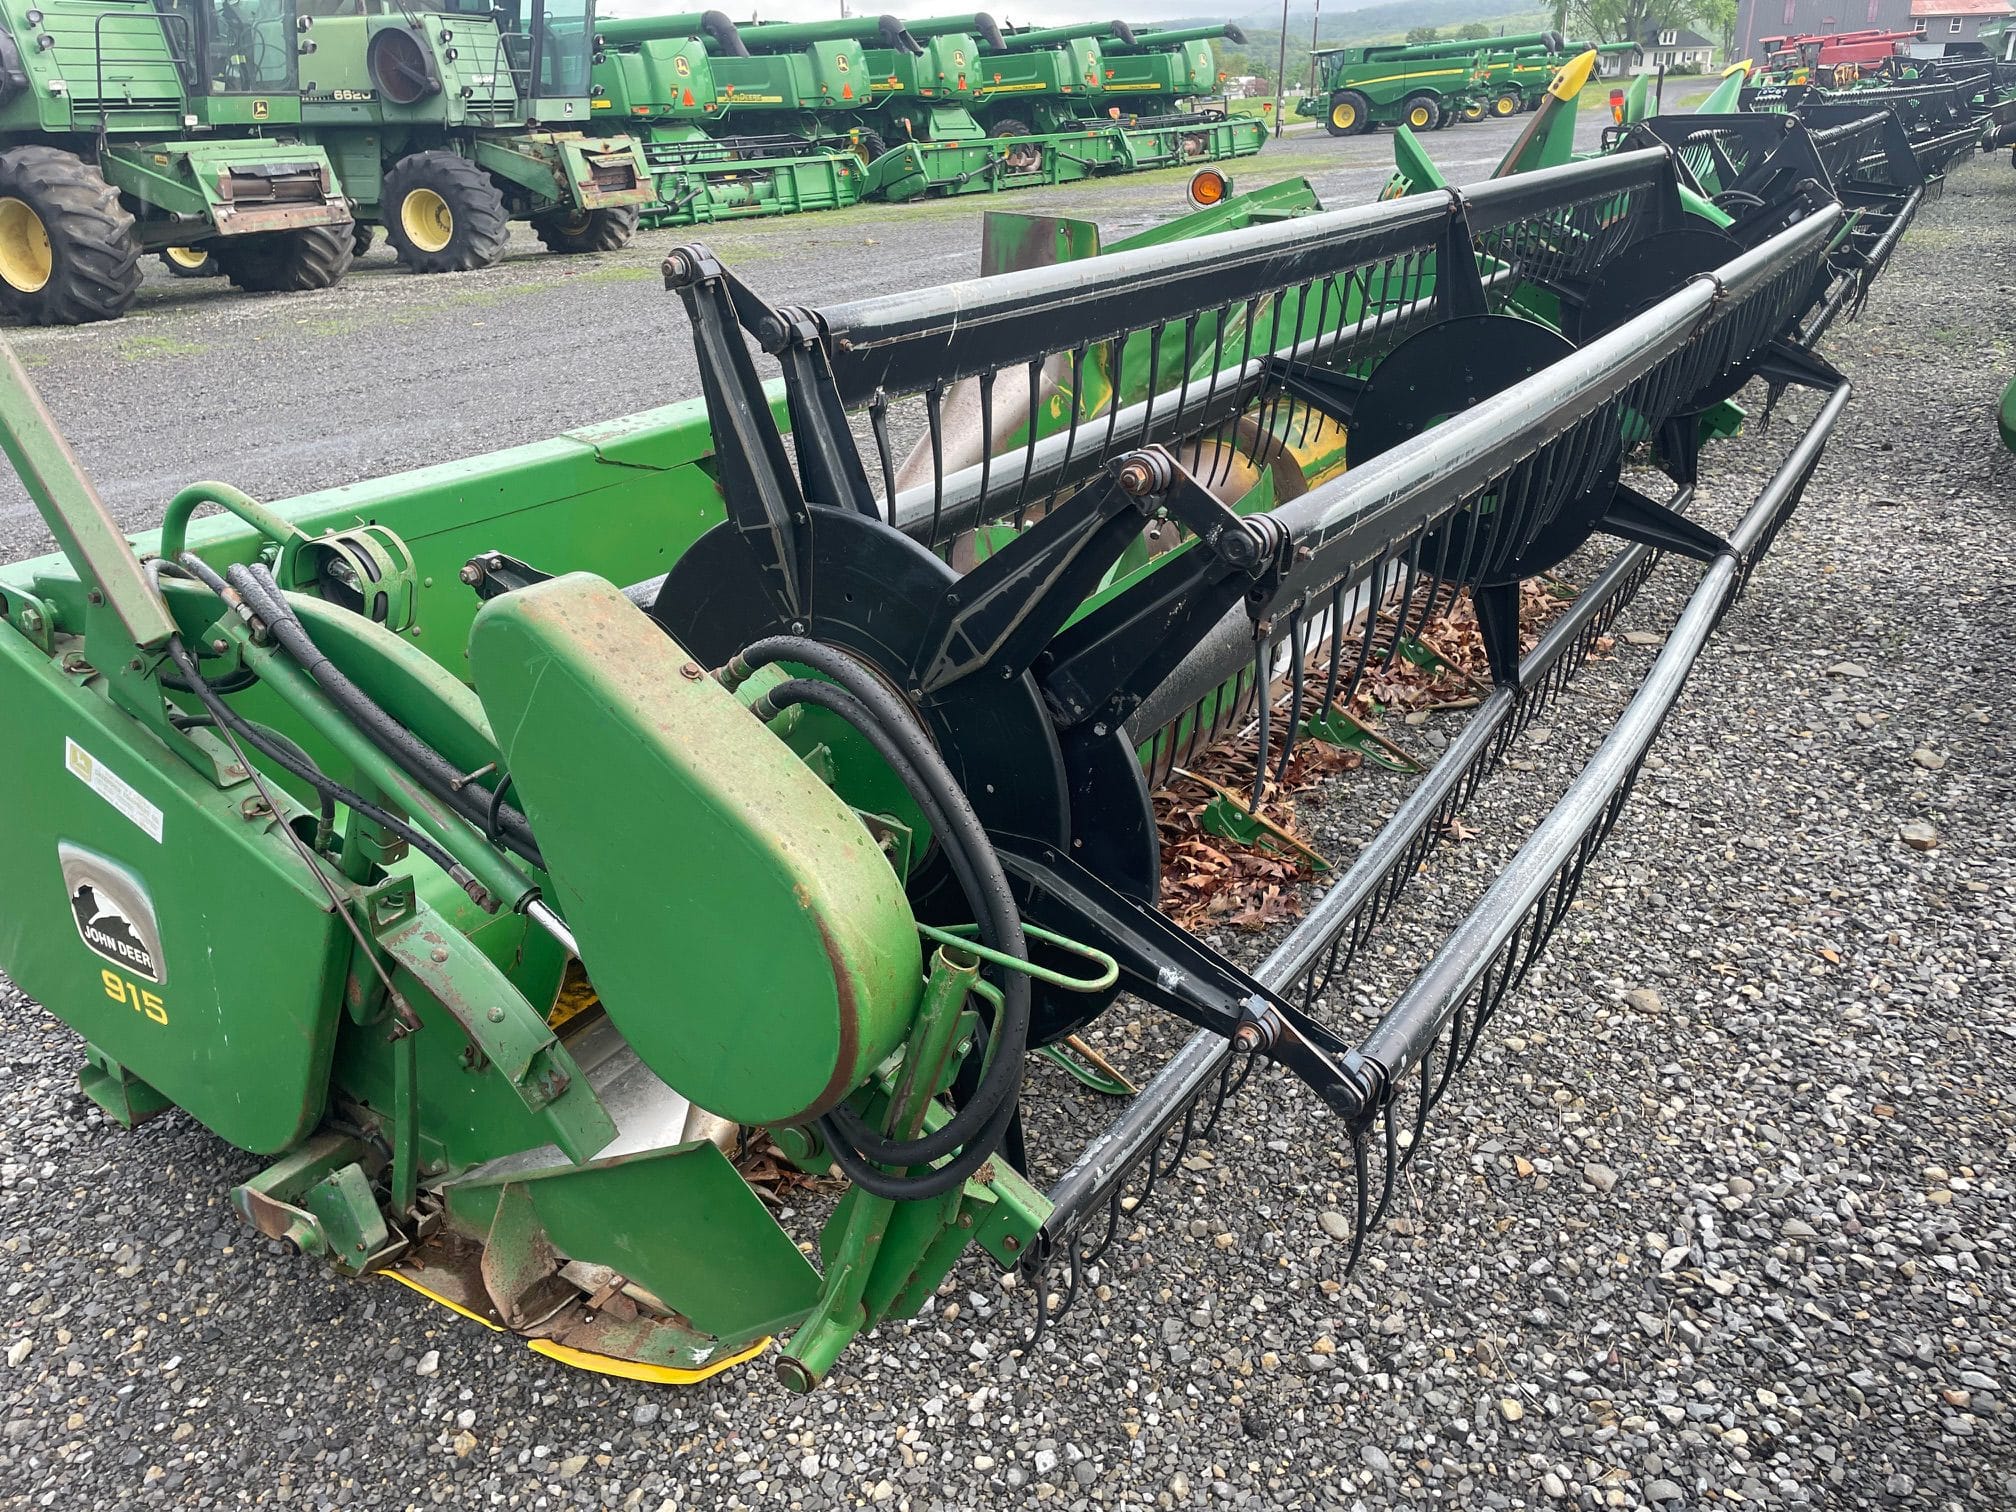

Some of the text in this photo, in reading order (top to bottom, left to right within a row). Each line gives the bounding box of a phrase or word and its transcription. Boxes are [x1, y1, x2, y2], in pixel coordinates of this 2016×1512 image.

[84, 925, 153, 969] JOHN DEER
[101, 968, 169, 1026] 915
